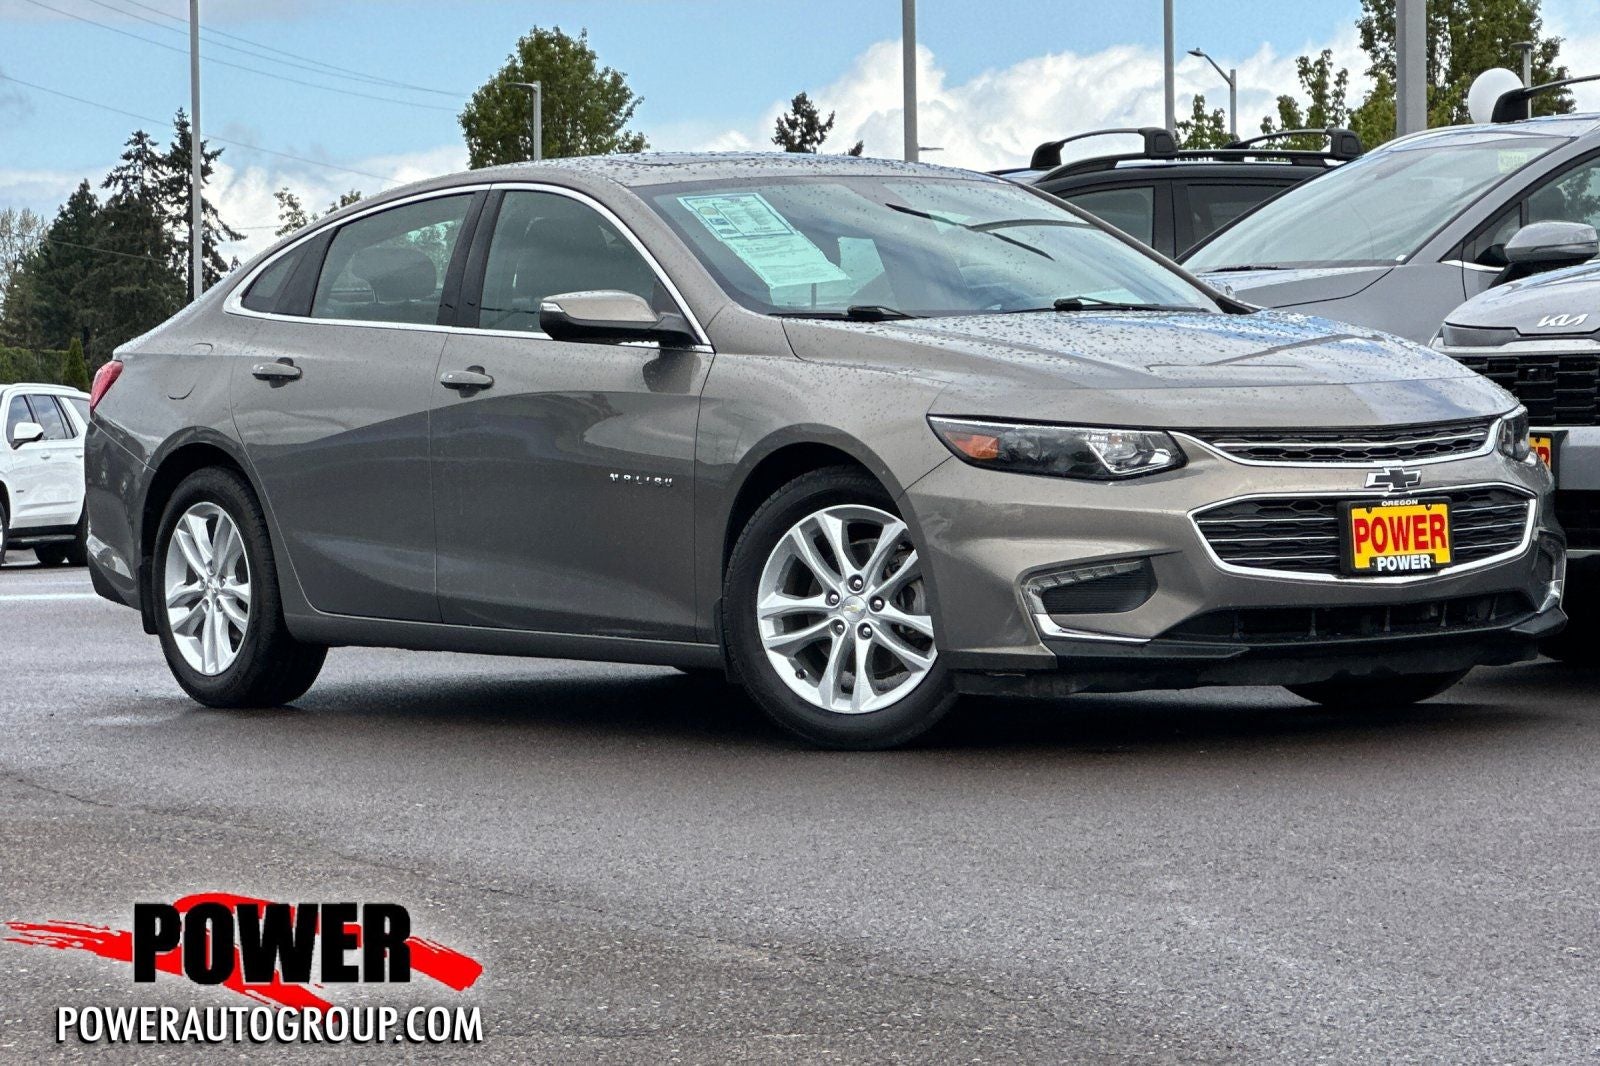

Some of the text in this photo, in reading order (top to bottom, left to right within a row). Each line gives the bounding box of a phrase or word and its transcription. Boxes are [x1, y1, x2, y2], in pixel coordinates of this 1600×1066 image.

[1381, 499, 1418, 507] OREGON
[1354, 514, 1447, 553] POWER
[1377, 554, 1431, 571] POWER
